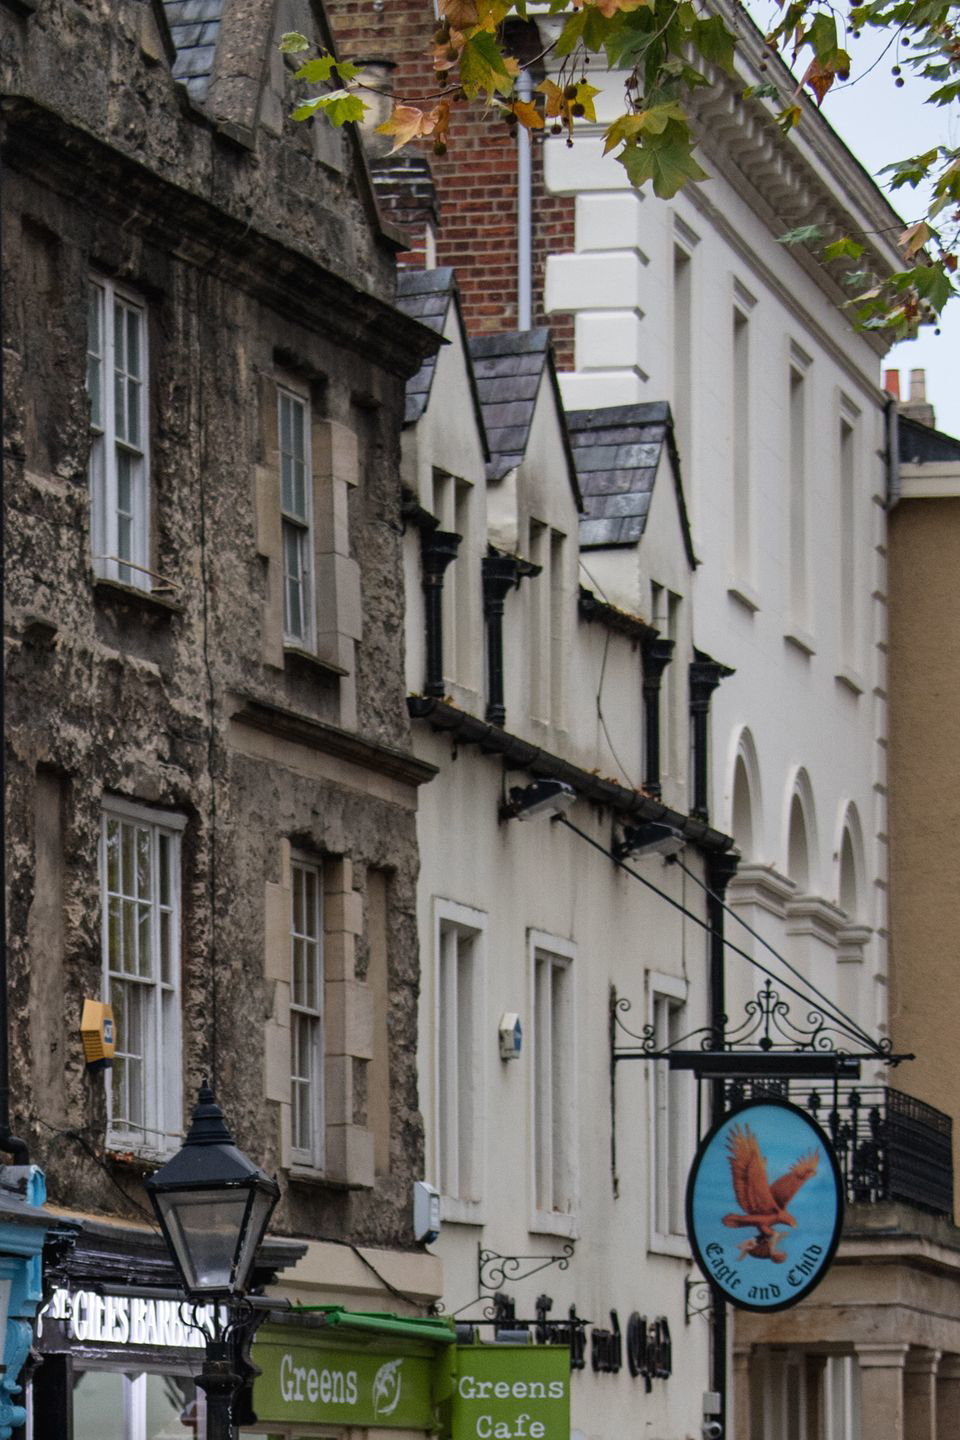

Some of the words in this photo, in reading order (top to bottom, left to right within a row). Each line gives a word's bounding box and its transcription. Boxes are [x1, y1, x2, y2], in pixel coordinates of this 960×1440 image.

[705, 1243, 742, 1290] Eagle
[748, 1284, 782, 1300] and
[787, 1244, 823, 1287] Child
[280, 1354, 358, 1405] Greens
[458, 1375, 565, 1400] Greens
[476, 1414, 546, 1440] Cafe
